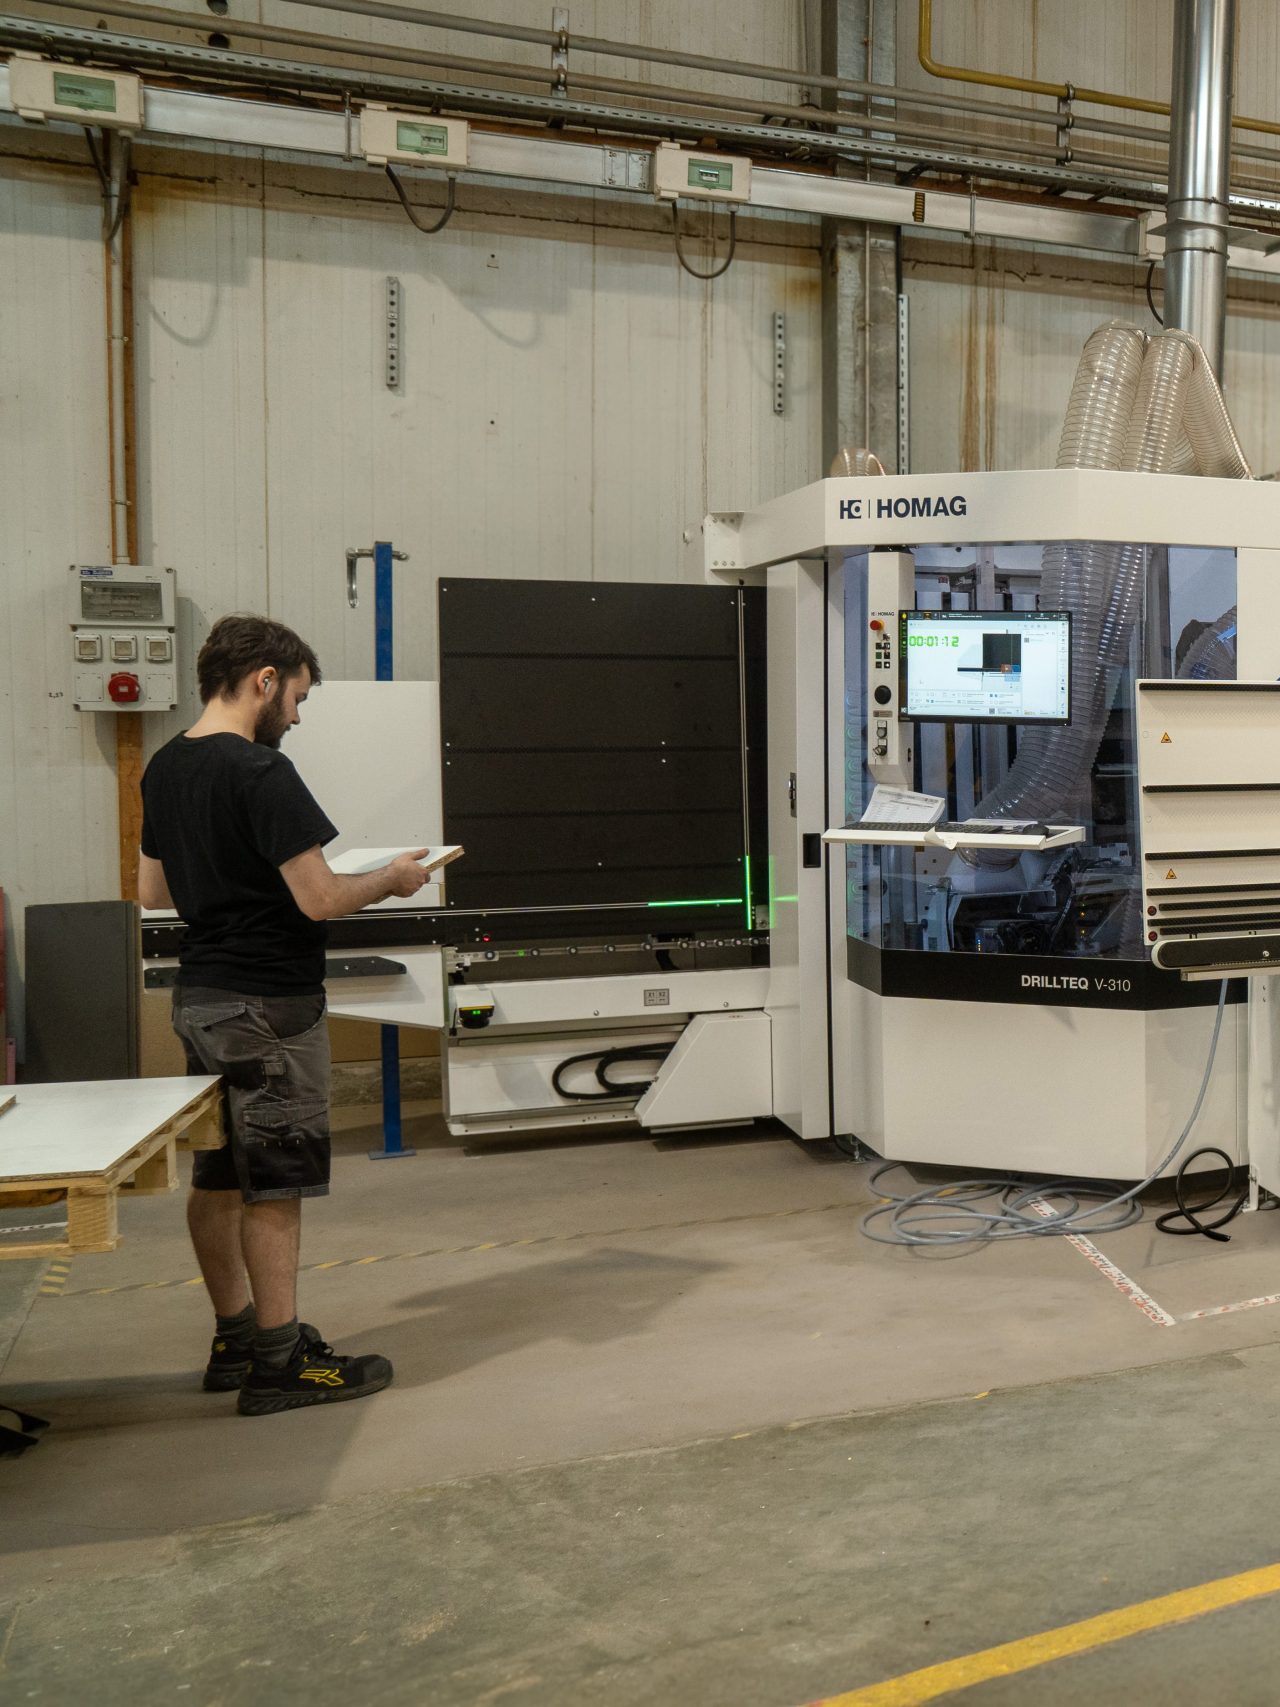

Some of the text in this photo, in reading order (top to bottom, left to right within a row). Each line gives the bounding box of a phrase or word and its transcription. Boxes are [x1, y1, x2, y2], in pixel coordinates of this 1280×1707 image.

[877, 495, 967, 519] HOMAG
[1021, 974, 1131, 992] DRILLTEQ V-310
